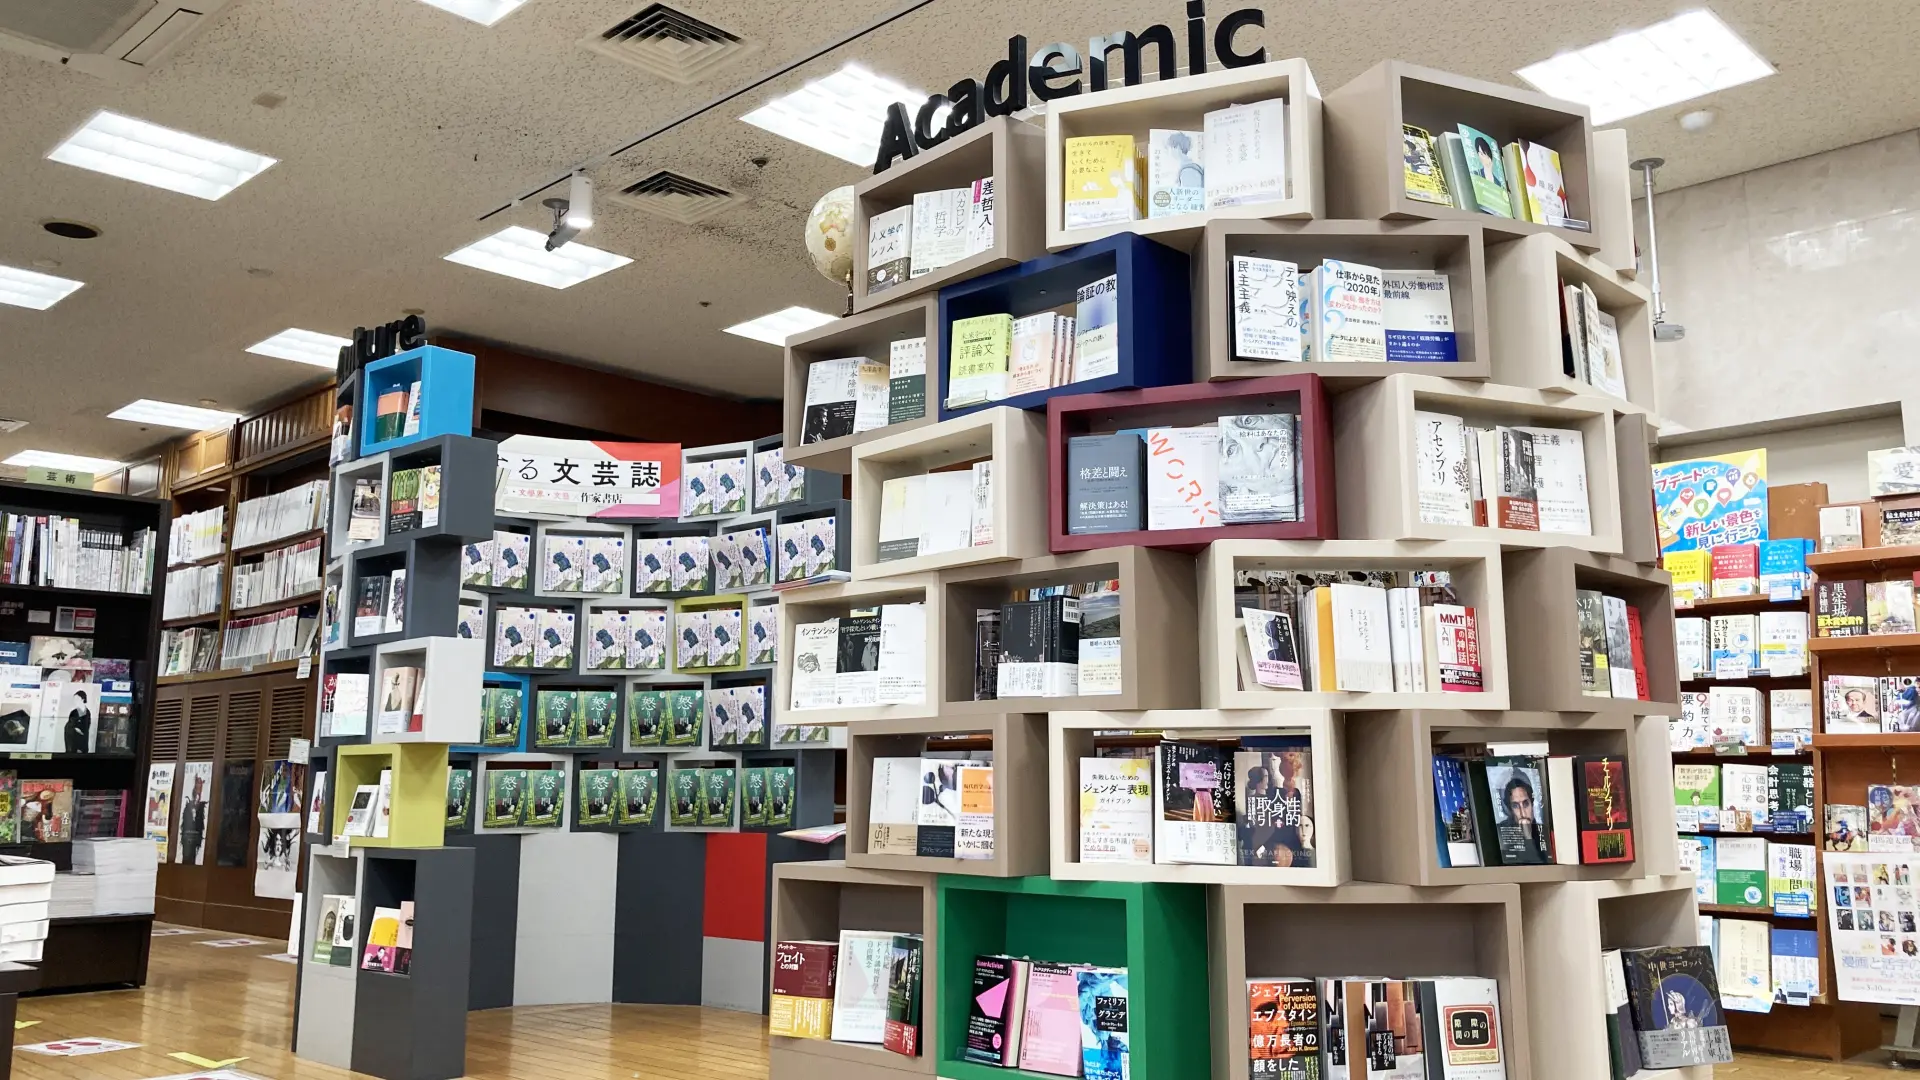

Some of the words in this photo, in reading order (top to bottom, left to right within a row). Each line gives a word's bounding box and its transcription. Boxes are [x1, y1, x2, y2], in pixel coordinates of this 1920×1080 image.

[873, 0, 1266, 173] Academic
[1071, 149, 1091, 157] 生きて
[1071, 157, 1106, 165] いくために
[1071, 166, 1106, 175] 必要なこと
[1237, 260, 1251, 315] 民主主義
[1336, 269, 1381, 288] 仕事から見た
[1382, 280, 1445, 292] 外国人労働相談
[1284, 265, 1298, 329] デマ映えの
[1342, 280, 1381, 299] 「2020年」
[1383, 290, 1411, 300] 最前線
[959, 342, 995, 360] 評論文
[958, 362, 995, 376] 読書案内
[847, 359, 860, 399] 吉本隆明
[1431, 420, 1446, 487] アセンブリ
[46, 471, 76, 484] 芸術
[1079, 465, 1128, 479] 格差と闘え
[1079, 500, 1129, 511] 解決策はある!
[1685, 509, 1762, 538] 新しい景色を
[1698, 525, 1761, 550] 見に行こう
[1439, 613, 1465, 626] MMT
[801, 627, 838, 641] インテンション
[1441, 627, 1450, 646] 入門
[1467, 615, 1478, 666] 財政赤字
[1713, 619, 1721, 649] すごい効果
[1721, 619, 1730, 663] 15分ミーティン
[1456, 629, 1467, 665] の神話
[1683, 694, 1694, 738] 要約力
[1727, 697, 1738, 725] 心理学
[1091, 773, 1140, 783] 失敗しないための
[1223, 761, 1233, 798] だけじゃ
[1083, 782, 1149, 797] ジェンダー表現
[1213, 770, 1223, 816] 始まらない
[1601, 756, 1615, 831] チェルノブイリ
[1742, 775, 1753, 803] 心理学
[1768, 765, 1780, 826] 会計思考
[1099, 797, 1132, 805] ガイドブック
[1271, 788, 1286, 818] 人身
[1257, 796, 1271, 828] 取引
[1286, 797, 1301, 828] 性的
[1788, 846, 1803, 896] 職場の問
[776, 952, 805, 969] フロイト
[1648, 957, 1703, 973] 中世ヨーロッパ
[1252, 984, 1316, 1000] ジェフリー・
[1279, 994, 1317, 1008] Perversion
[1097, 1010, 1127, 1020] グランデ
[1291, 1001, 1317, 1010] Justice
[1252, 1008, 1317, 1024] エプスタイン
[1252, 1033, 1317, 1048] 億万長者の
[1253, 1058, 1299, 1073] 顔をした
